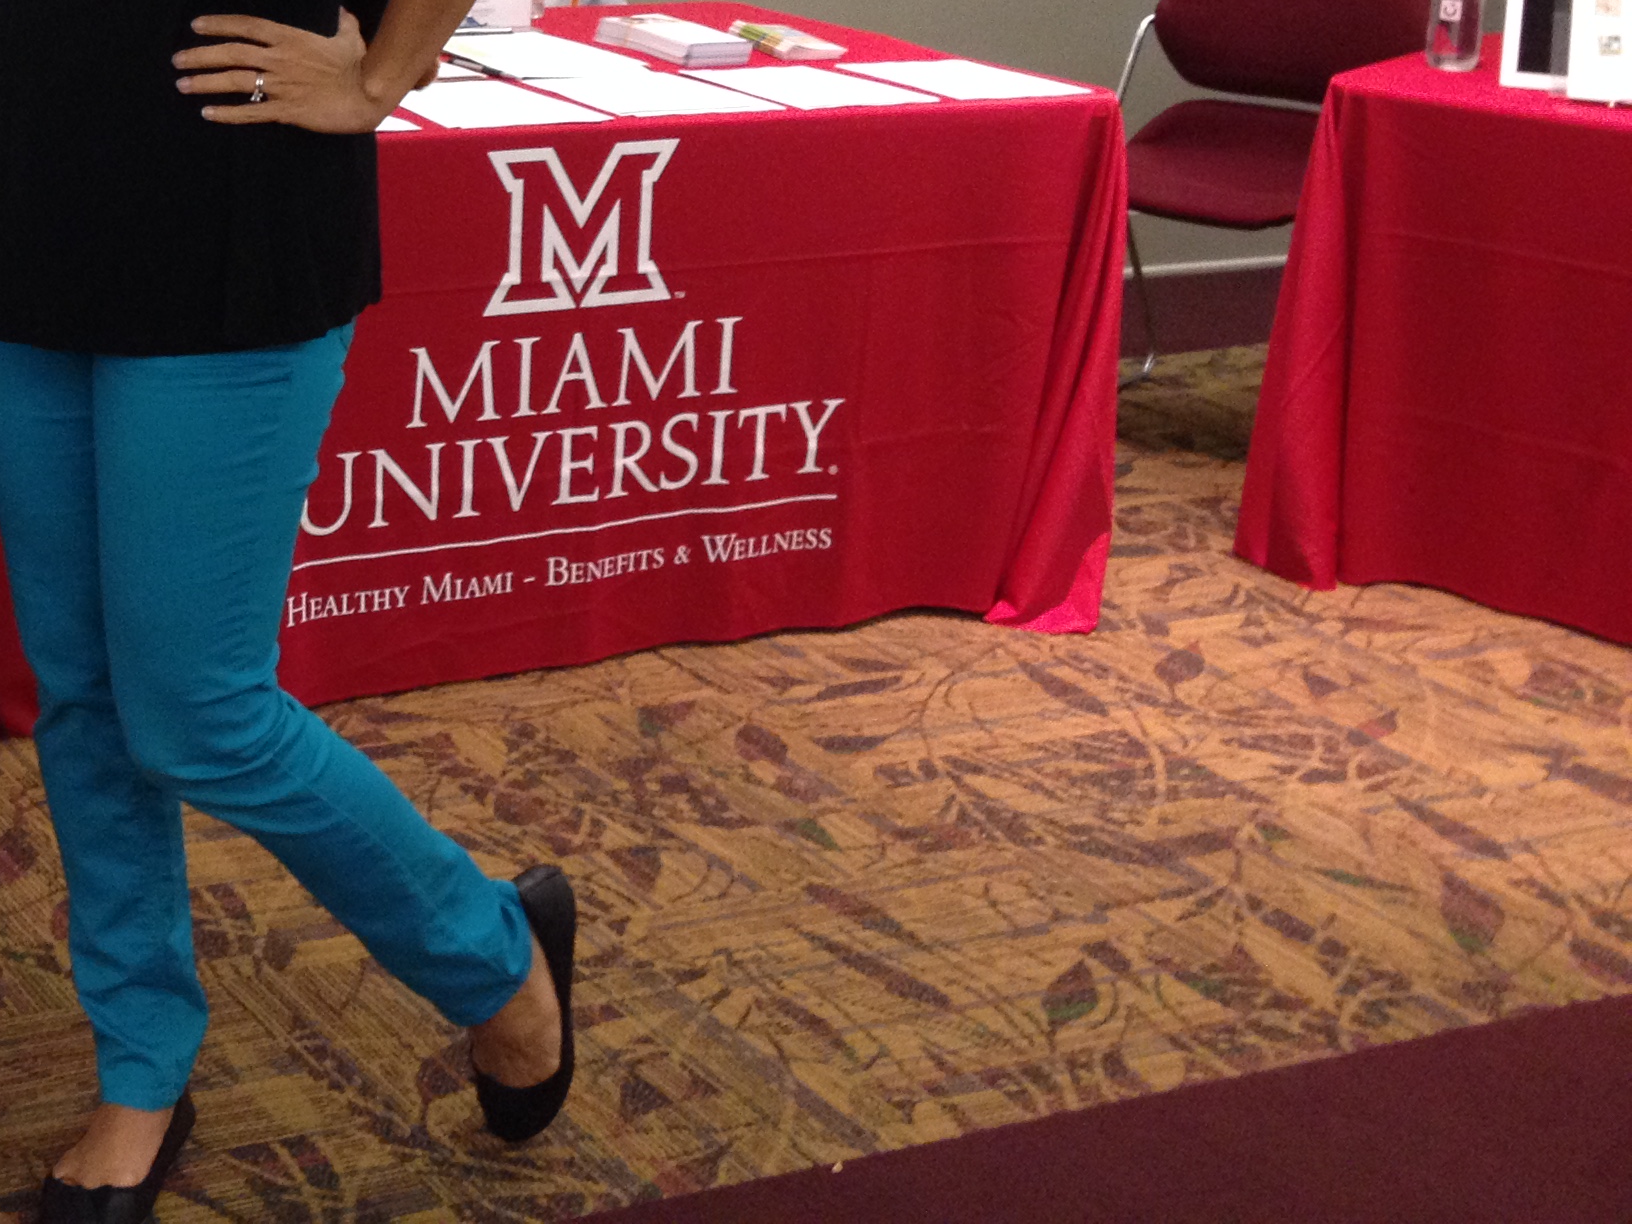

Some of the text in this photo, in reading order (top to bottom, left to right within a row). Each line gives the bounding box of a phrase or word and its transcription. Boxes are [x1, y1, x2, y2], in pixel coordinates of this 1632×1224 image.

[406, 316, 744, 428] MIAMI
[300, 398, 845, 536] UNIVERSITY
[674, 545, 691, 565] &
